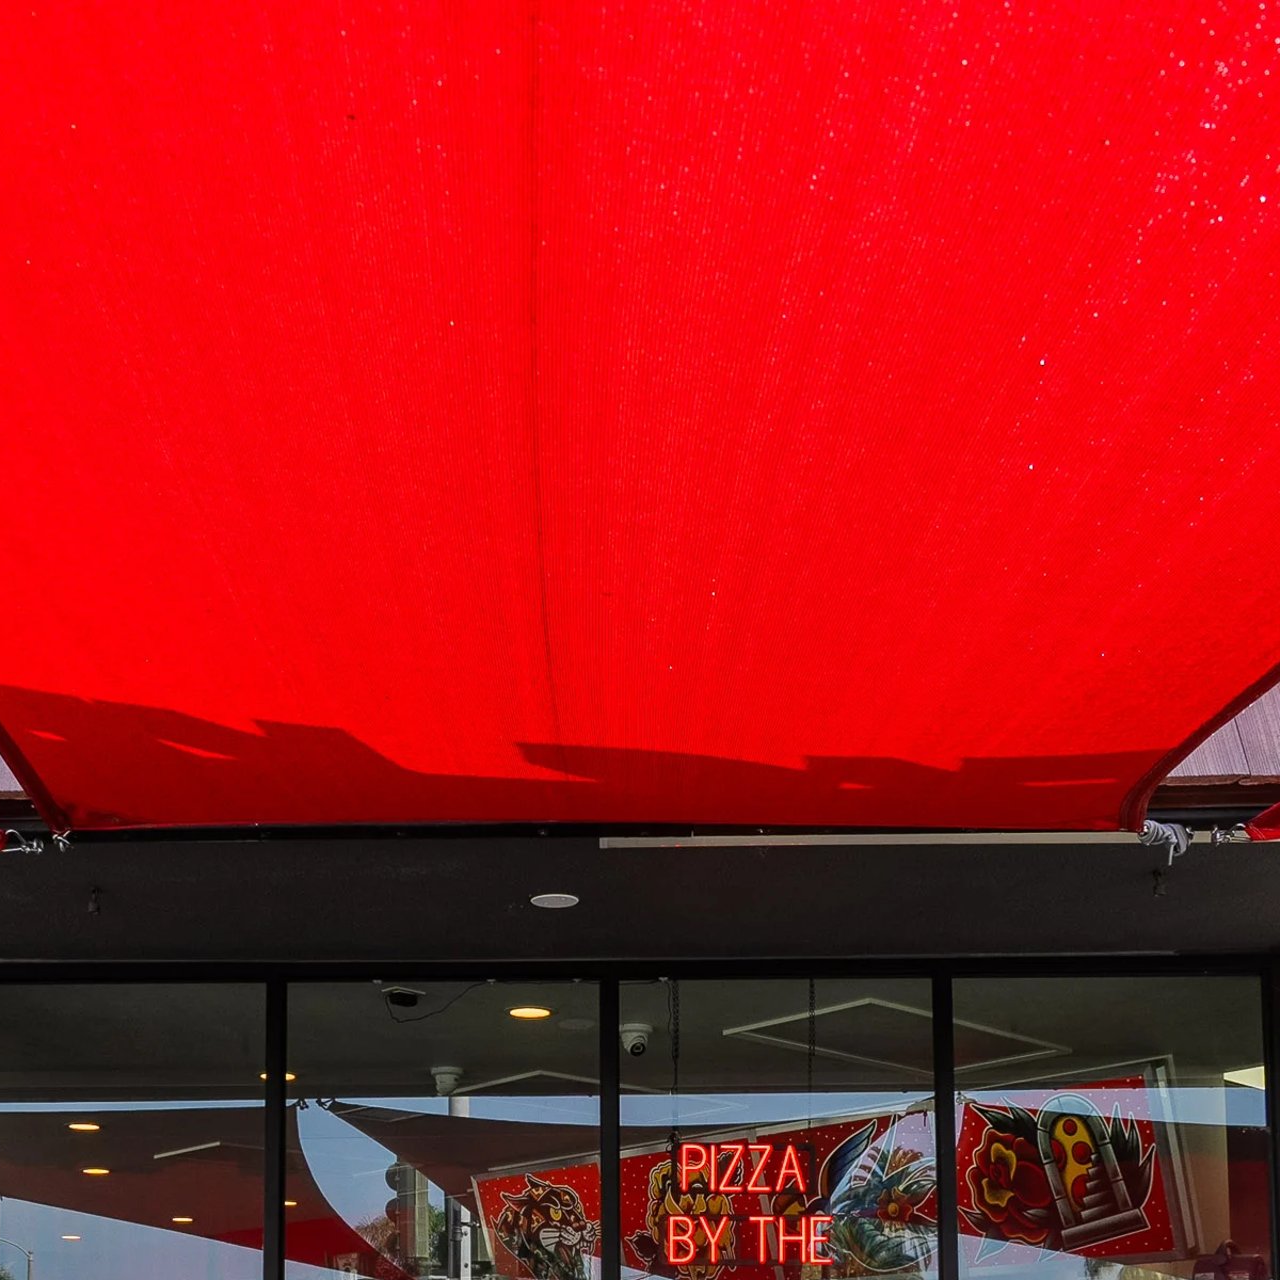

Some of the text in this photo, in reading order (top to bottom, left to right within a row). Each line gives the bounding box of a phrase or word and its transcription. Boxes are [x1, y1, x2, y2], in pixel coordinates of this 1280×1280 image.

[679, 1143, 806, 1193] PIZZA
[667, 1215, 834, 1264] BY THE
